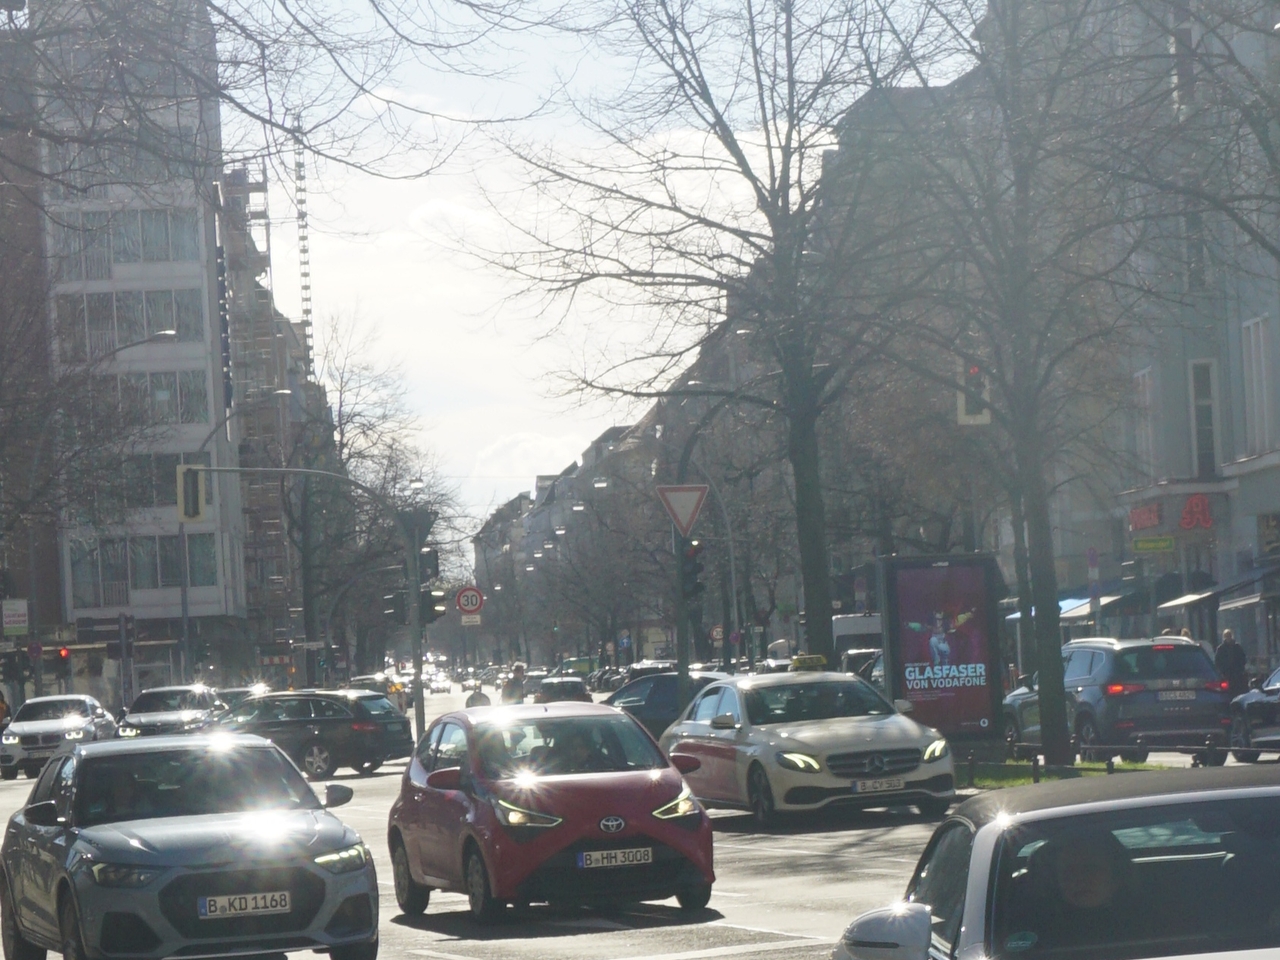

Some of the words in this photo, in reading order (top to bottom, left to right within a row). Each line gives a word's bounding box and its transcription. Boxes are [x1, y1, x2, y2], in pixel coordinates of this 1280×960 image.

[462, 594, 478, 607] 30
[905, 663, 986, 680] GLASFASER
[906, 679, 929, 689] VON
[930, 676, 987, 688] VODAFONE
[584, 853, 593, 866] B
[601, 852, 617, 865] HH
[620, 849, 650, 863] 3008
[208, 898, 218, 914] B
[228, 896, 248, 912] KD
[251, 893, 288, 910] 1168
